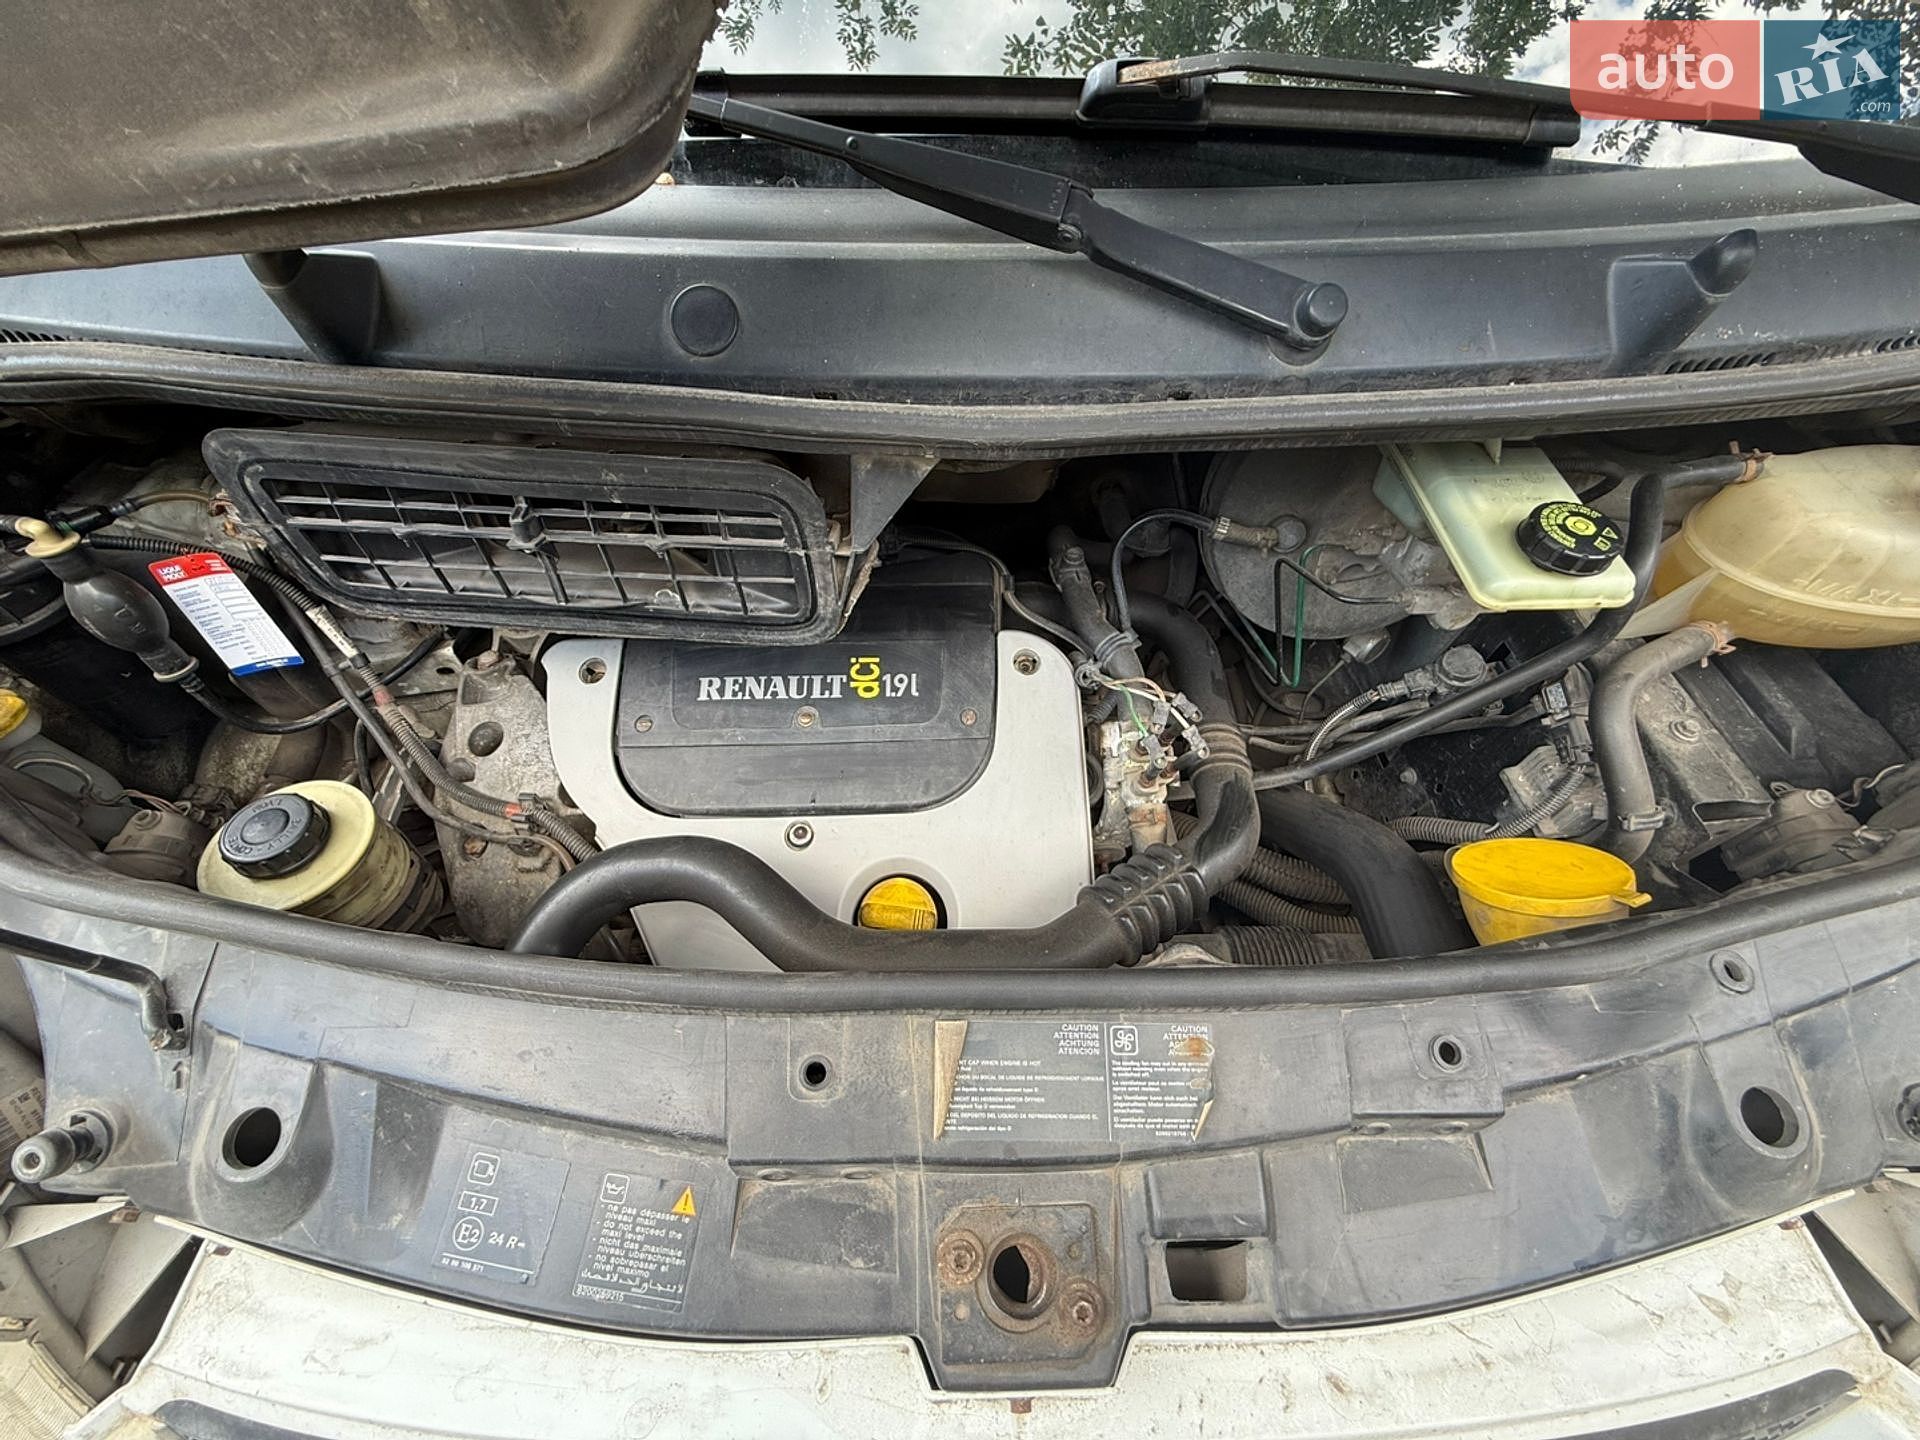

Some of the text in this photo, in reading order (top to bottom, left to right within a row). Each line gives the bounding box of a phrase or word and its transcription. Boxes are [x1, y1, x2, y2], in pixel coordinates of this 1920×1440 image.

[697, 674, 848, 701] RENAULT
[850, 657, 881, 699] dCi
[1062, 1023, 1099, 1032] CAUTION
[1171, 1025, 1208, 1033] CAUTION
[1053, 1031, 1100, 1040] ATTENTION
[1059, 1039, 1100, 1047] ACHTUNG
[608, 1204, 619, 1212] ne
[622, 1206, 637, 1215] pas
[456, 1223, 480, 1243] E2
[603, 1220, 615, 1228] do
[618, 1222, 633, 1231] not
[668, 1229, 683, 1240] the
[488, 1232, 505, 1246] 24
